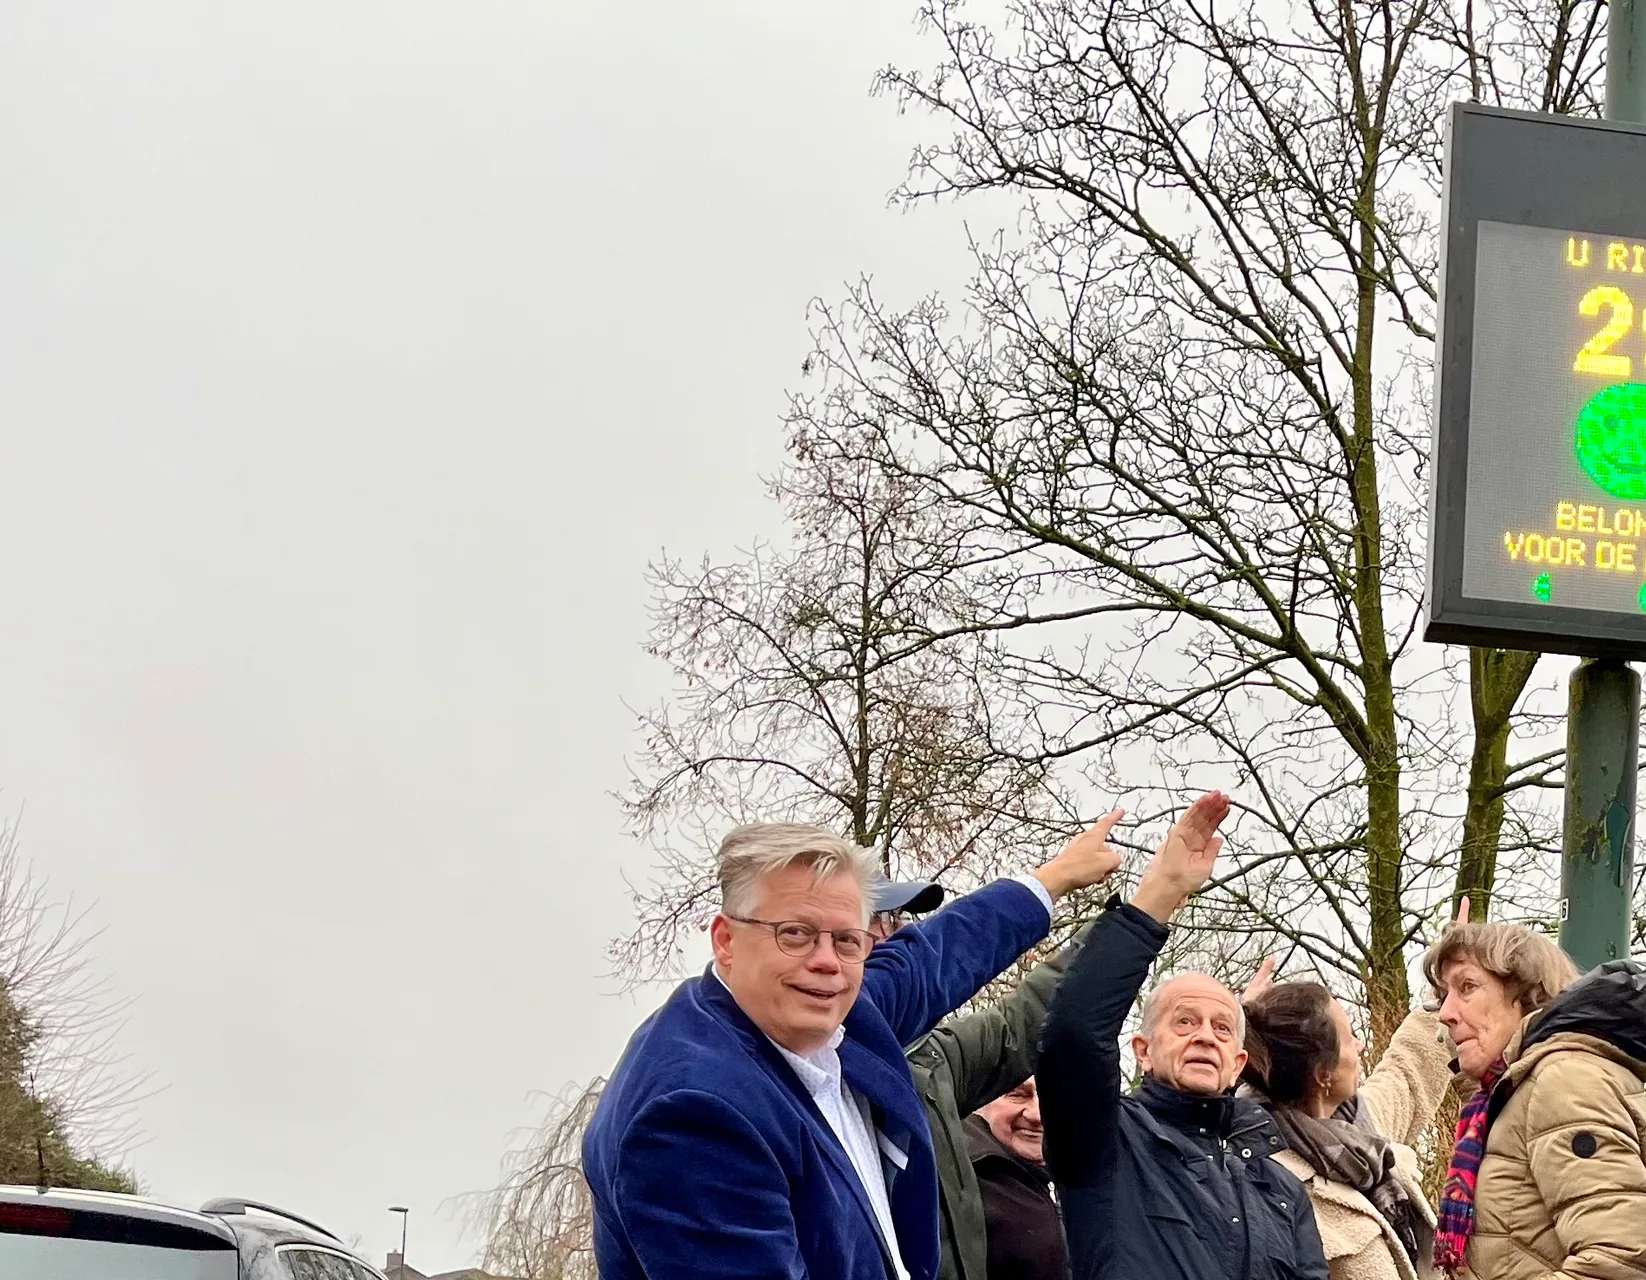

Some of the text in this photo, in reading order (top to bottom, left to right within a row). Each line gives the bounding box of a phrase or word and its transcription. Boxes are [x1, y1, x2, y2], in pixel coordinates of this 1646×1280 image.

[1567, 237, 1589, 267] U
[1504, 531, 1586, 566] VOOR
[1595, 541, 1637, 572] DE
